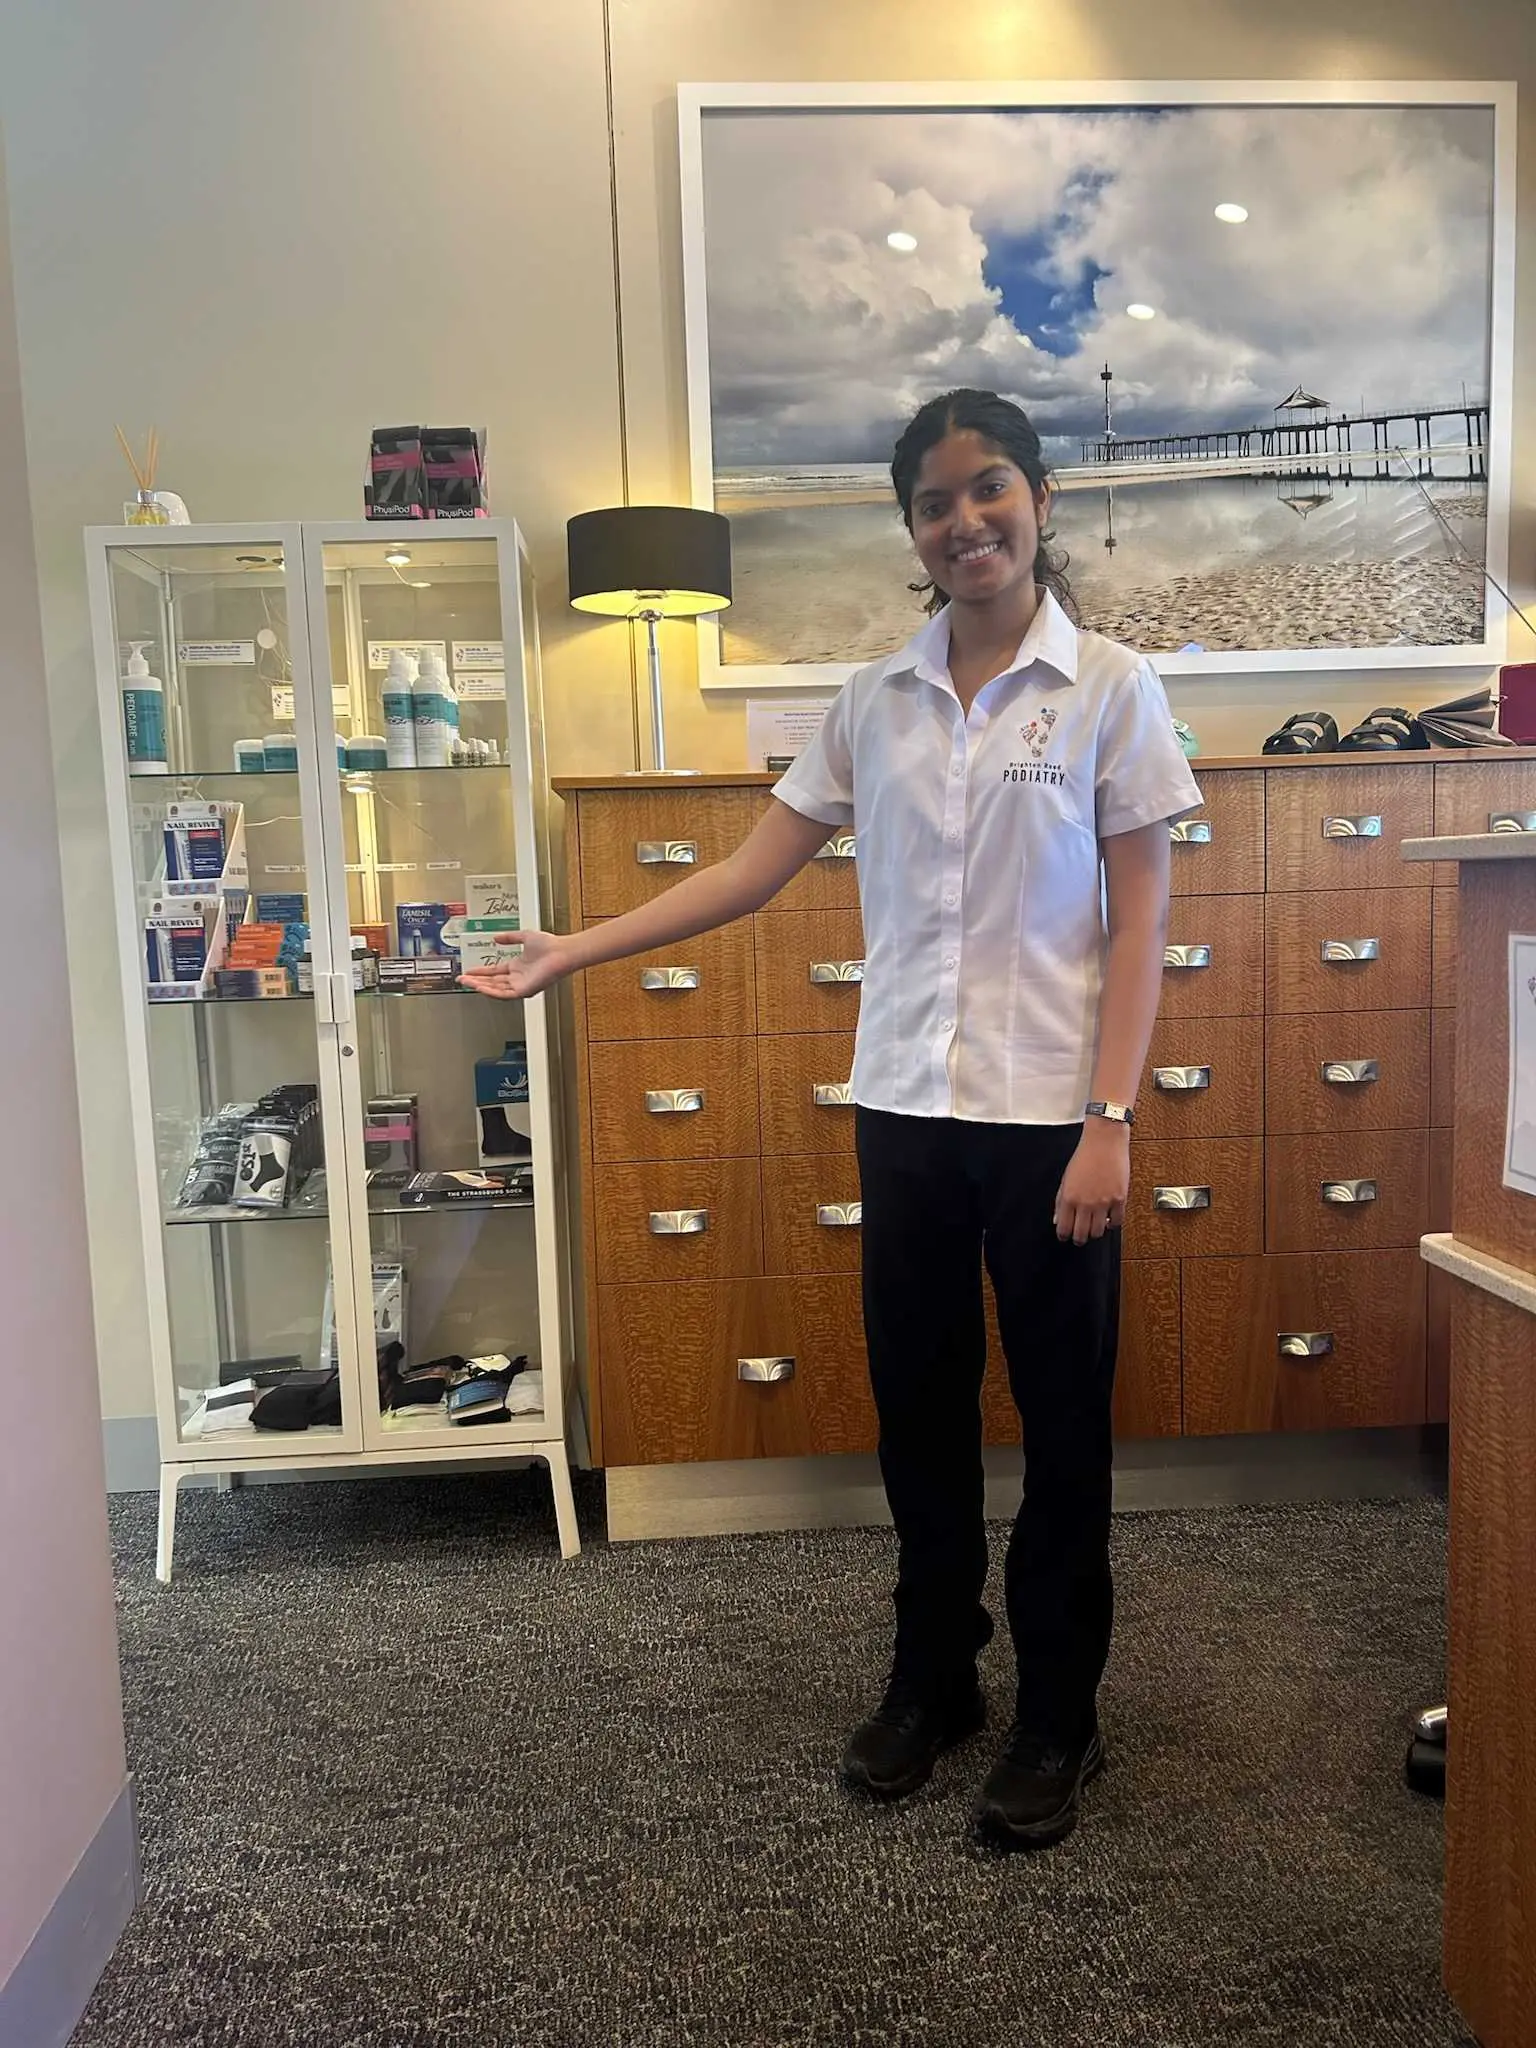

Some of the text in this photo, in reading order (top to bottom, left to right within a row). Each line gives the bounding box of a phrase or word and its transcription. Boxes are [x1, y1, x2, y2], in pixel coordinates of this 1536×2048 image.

[373, 504, 410, 515] PhysiPod
[437, 508, 474, 518] PhysiPod
[126, 693, 138, 737] PEDICARE
[1003, 769, 1065, 786] PODIATRY
[187, 821, 217, 829] REVIVE
[483, 897, 519, 915] Islan
[170, 919, 201, 927] REVIVE
